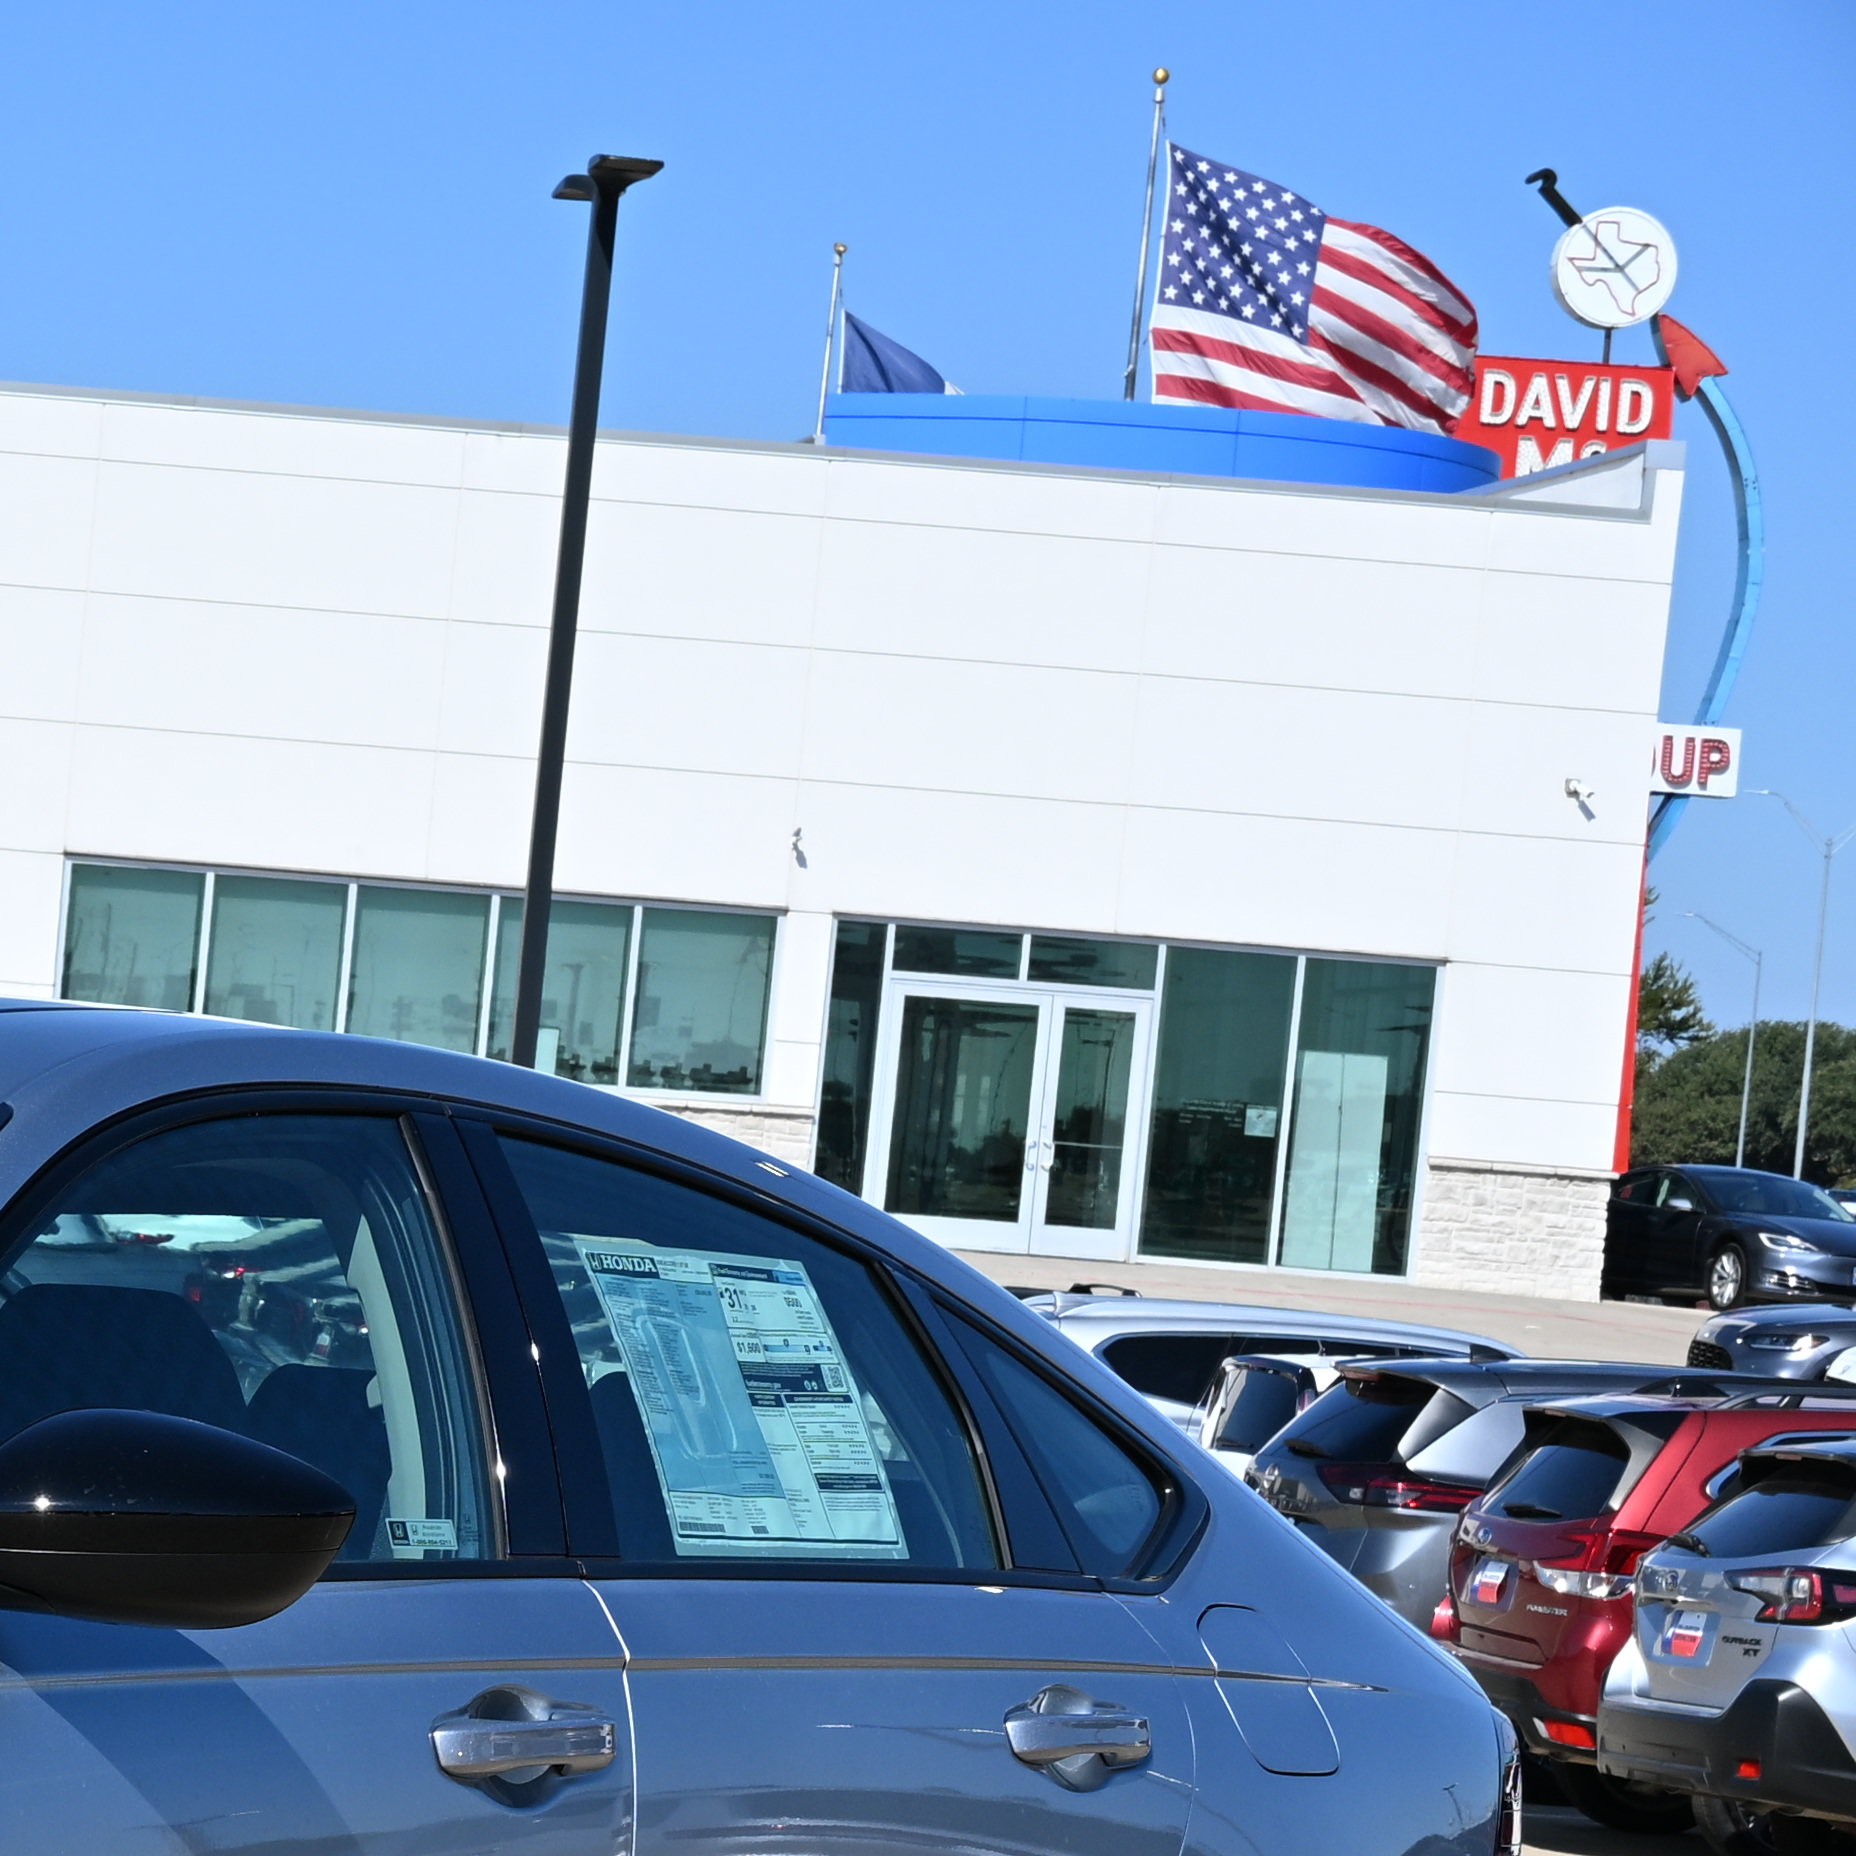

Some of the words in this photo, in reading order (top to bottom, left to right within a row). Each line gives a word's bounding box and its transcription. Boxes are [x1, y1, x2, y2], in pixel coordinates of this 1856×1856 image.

[1480, 368, 1654, 434] DAVID
[1650, 734, 1731, 791] UP
[600, 1254, 657, 1273] HONDA
